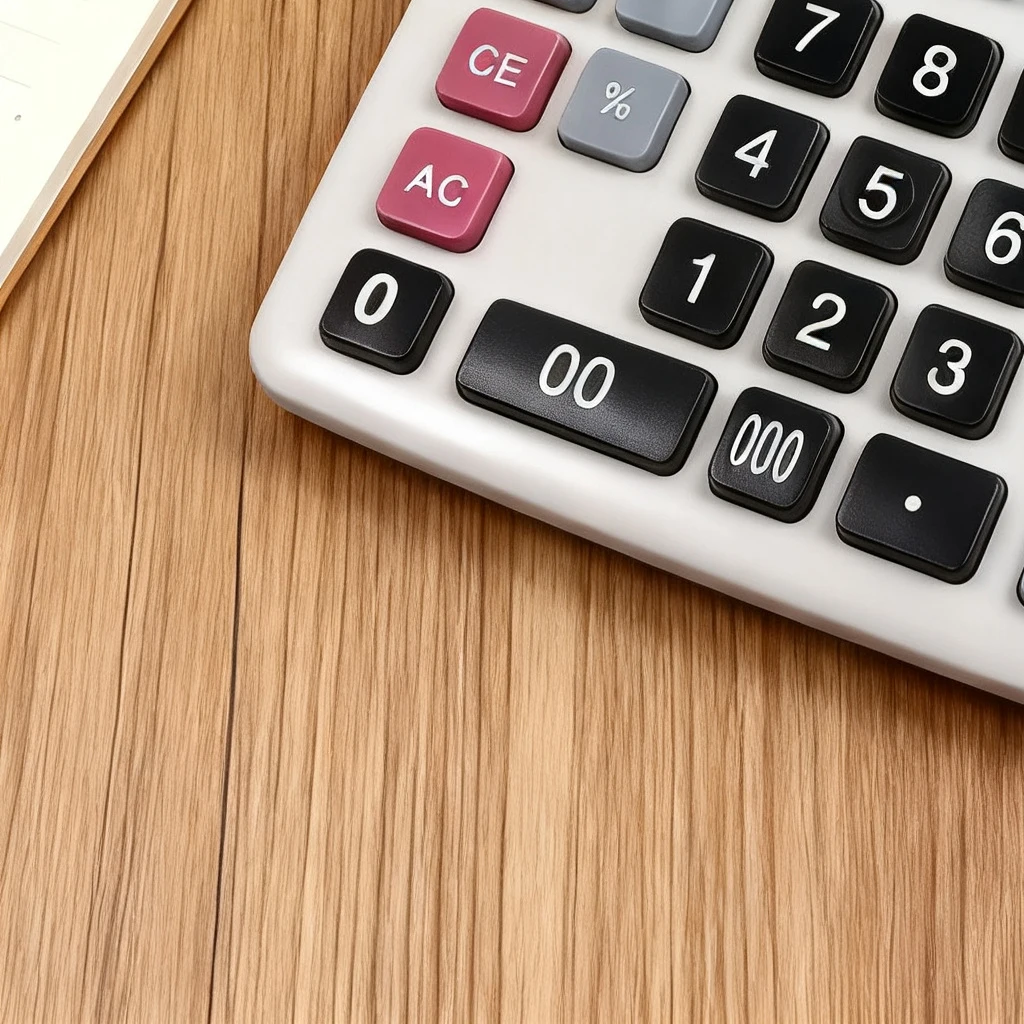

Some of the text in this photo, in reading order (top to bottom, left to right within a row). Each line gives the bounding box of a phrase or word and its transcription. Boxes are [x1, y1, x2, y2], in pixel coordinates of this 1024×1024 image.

[794, 2, 841, 52] 7
[468, 44, 529, 88] CE
[912, 44, 958, 97] 8
[733, 129, 779, 179] 4
[404, 164, 469, 208] AC
[858, 164, 905, 221] 5
[353, 272, 399, 326] 0
[686, 252, 717, 305] 1
[795, 292, 847, 351] 2
[537, 343, 616, 410] 00
[926, 338, 973, 396] 3
[729, 413, 805, 484] 000
